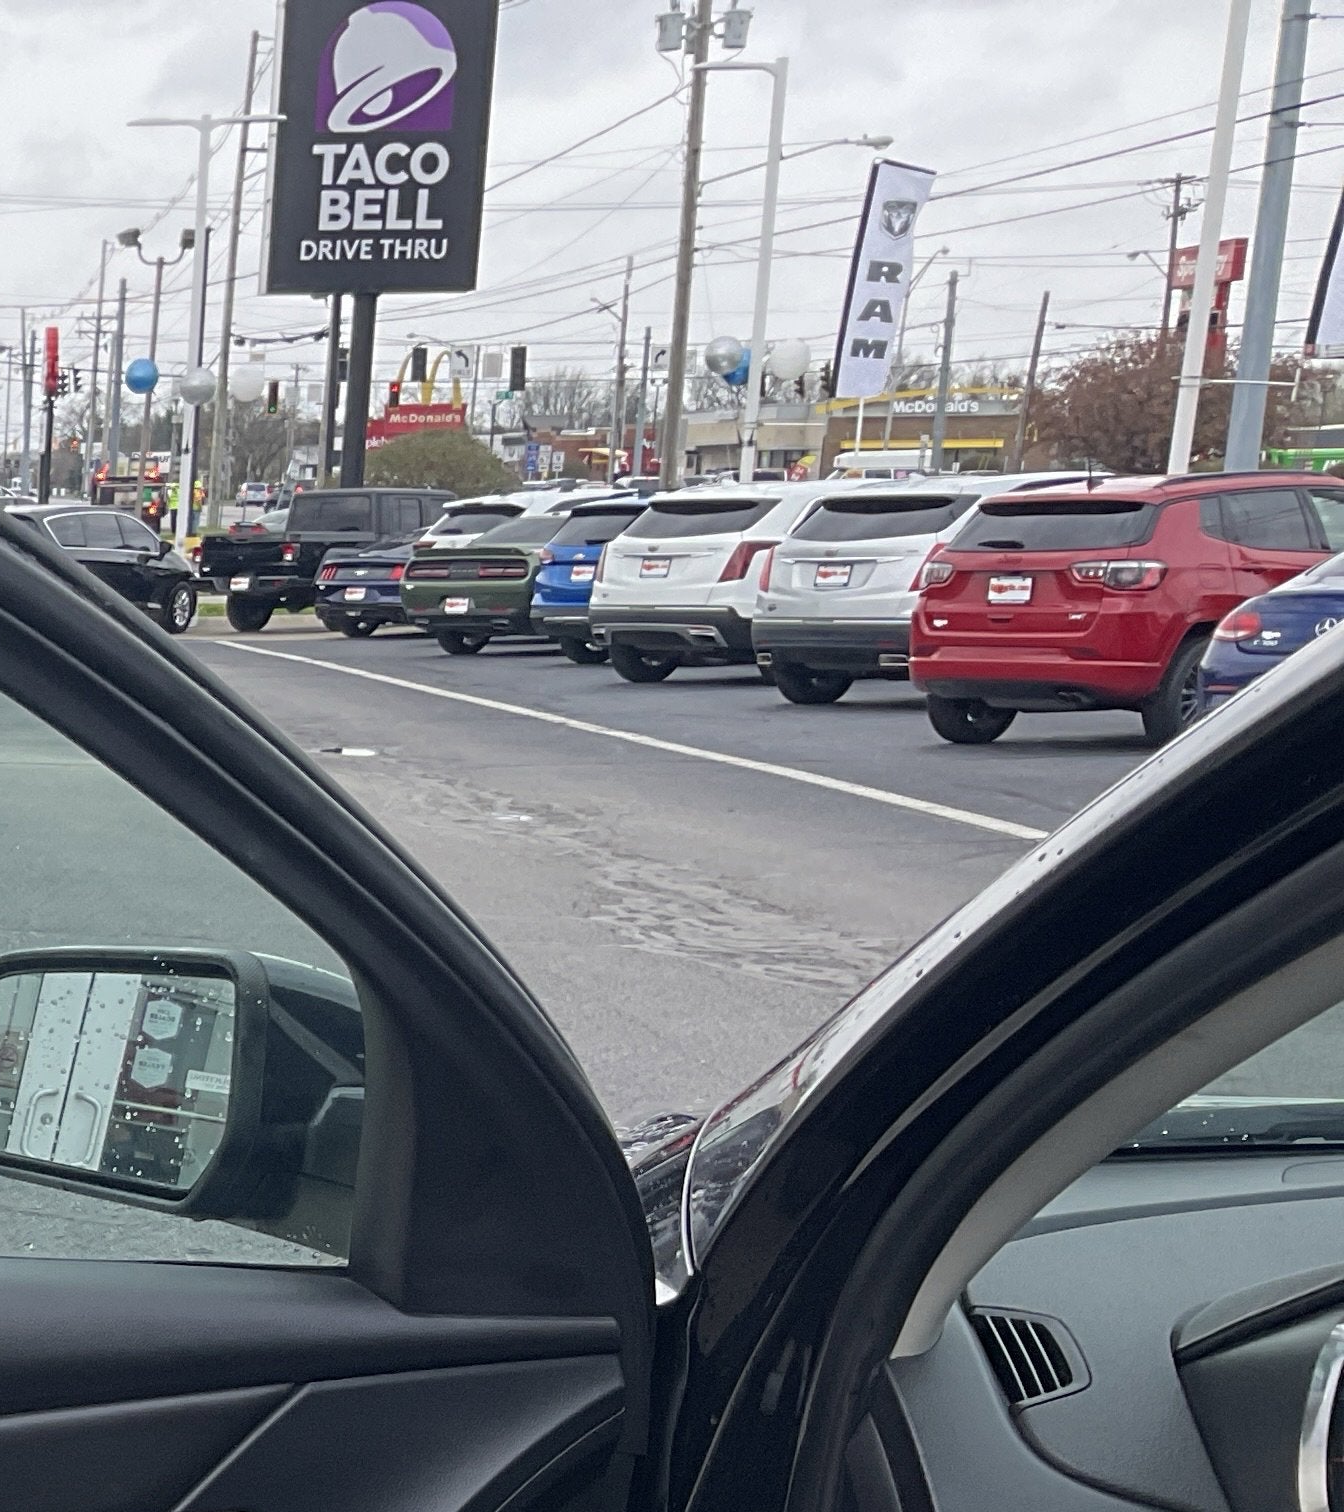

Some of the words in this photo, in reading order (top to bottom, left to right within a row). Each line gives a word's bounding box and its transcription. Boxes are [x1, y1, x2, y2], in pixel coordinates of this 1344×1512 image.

[312, 142, 450, 185] TACO
[318, 188, 443, 231] BELL
[299, 239, 372, 261] DRIVE
[380, 238, 448, 260] THRU
[850, 259, 904, 360] RAM
[389, 413, 461, 424] McDonald's
[892, 400, 980, 413] McDoald's
